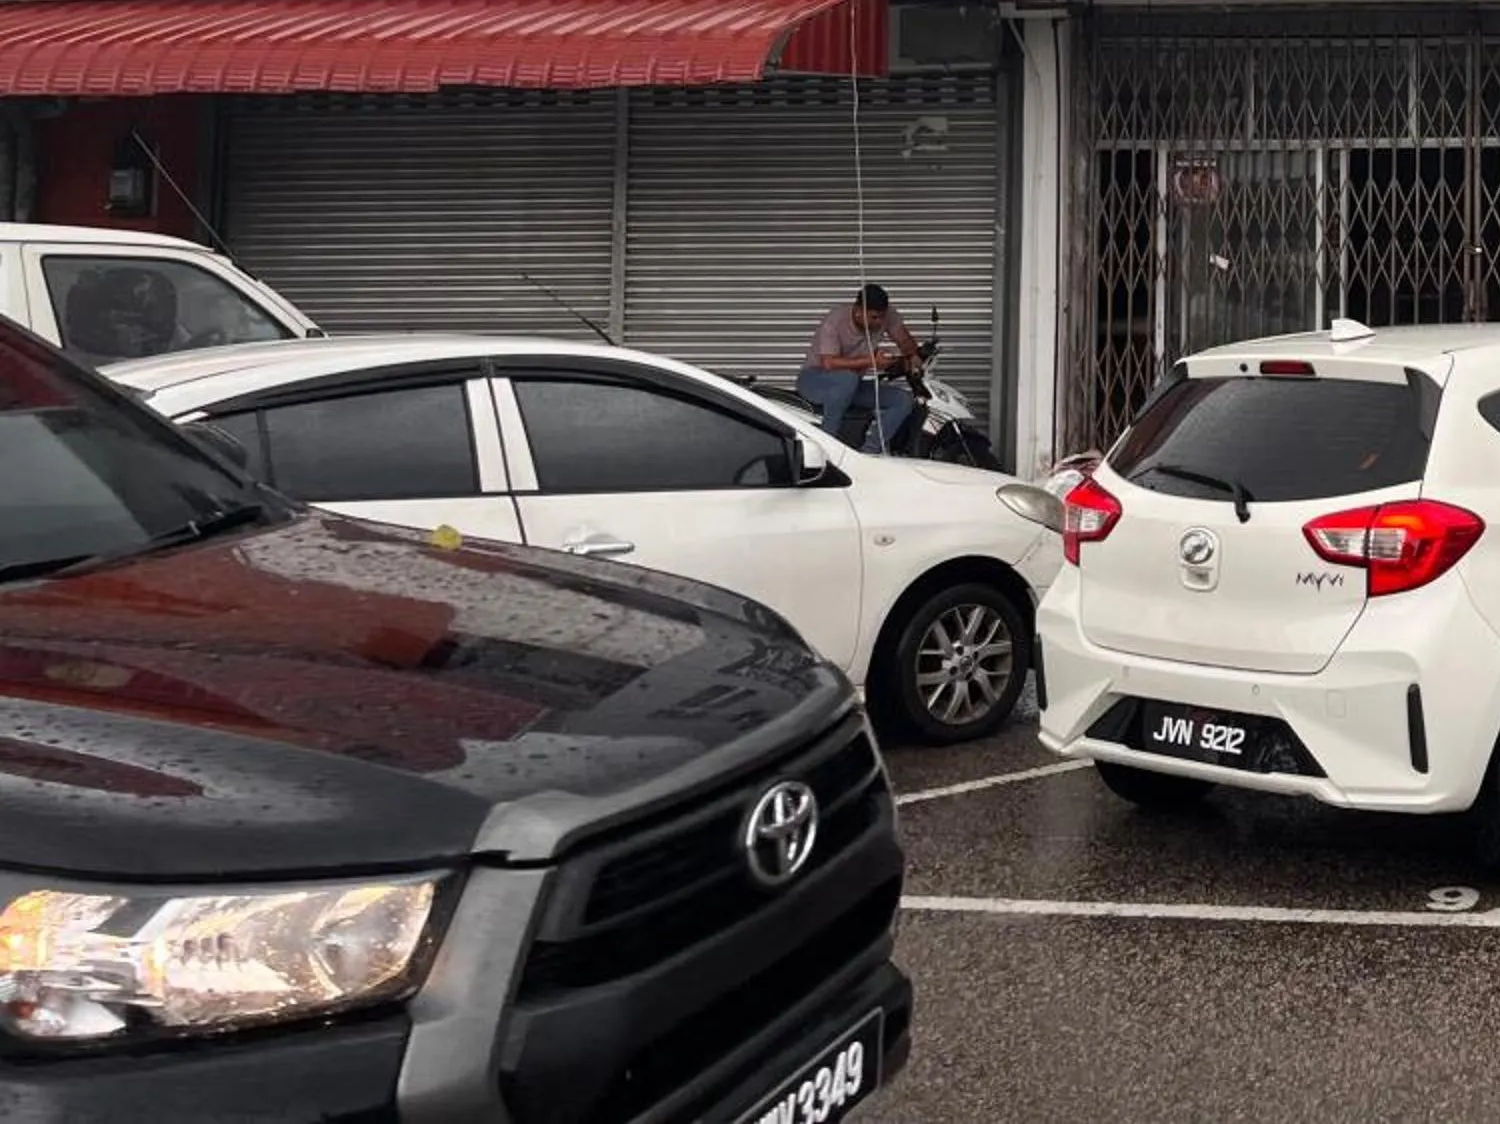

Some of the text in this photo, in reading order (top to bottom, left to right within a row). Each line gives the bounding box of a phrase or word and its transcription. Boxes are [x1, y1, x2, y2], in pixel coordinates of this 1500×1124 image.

[1153, 716, 1245, 755] JVN 9212
[1425, 886, 1480, 911] 9
[797, 1041, 864, 1124] 3349
